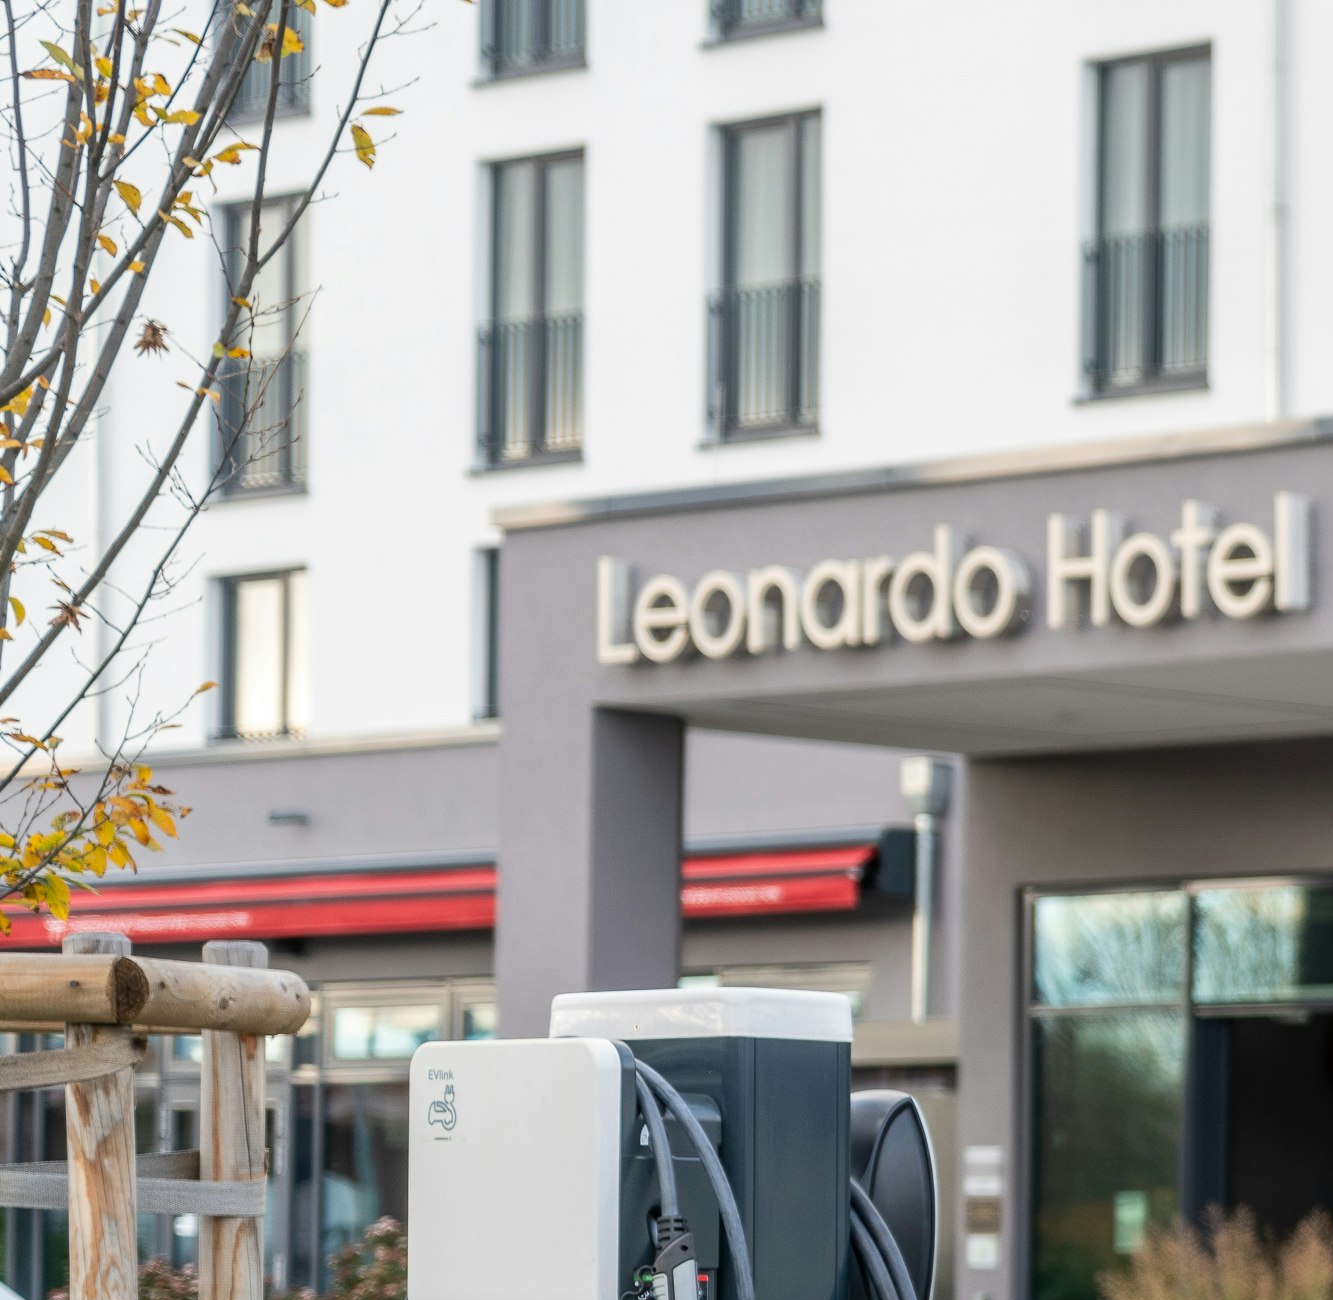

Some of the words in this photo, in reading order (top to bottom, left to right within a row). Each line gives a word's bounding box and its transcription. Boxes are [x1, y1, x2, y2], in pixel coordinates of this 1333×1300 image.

[597, 523, 1022, 664] Leonardo
[1047, 491, 1309, 629] Hotel
[428, 1069, 454, 1081] EVlink
